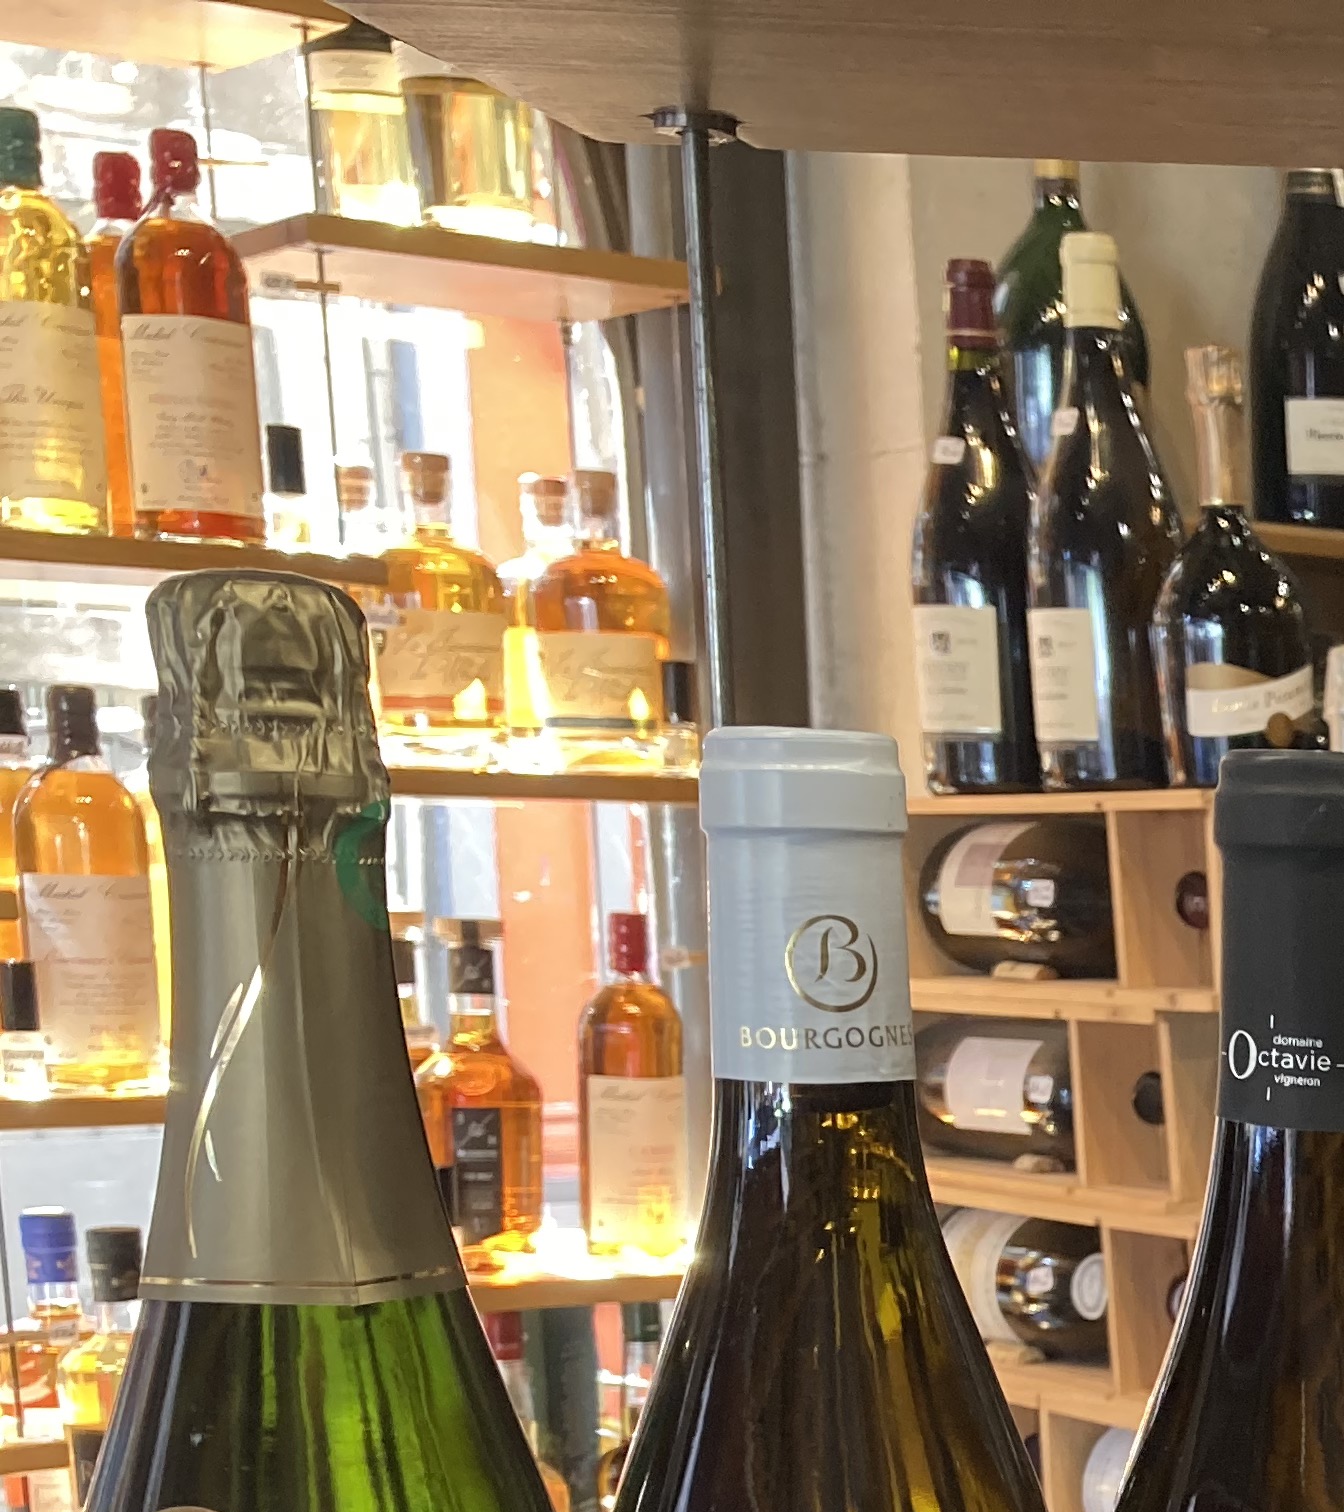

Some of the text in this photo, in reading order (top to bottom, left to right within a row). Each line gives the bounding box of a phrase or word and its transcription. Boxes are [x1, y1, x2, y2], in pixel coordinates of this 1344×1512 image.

[1272, 1034, 1323, 1048] domaine
[1228, 1029, 1332, 1080] Octavie
[1273, 1073, 1321, 1087] vigneron
